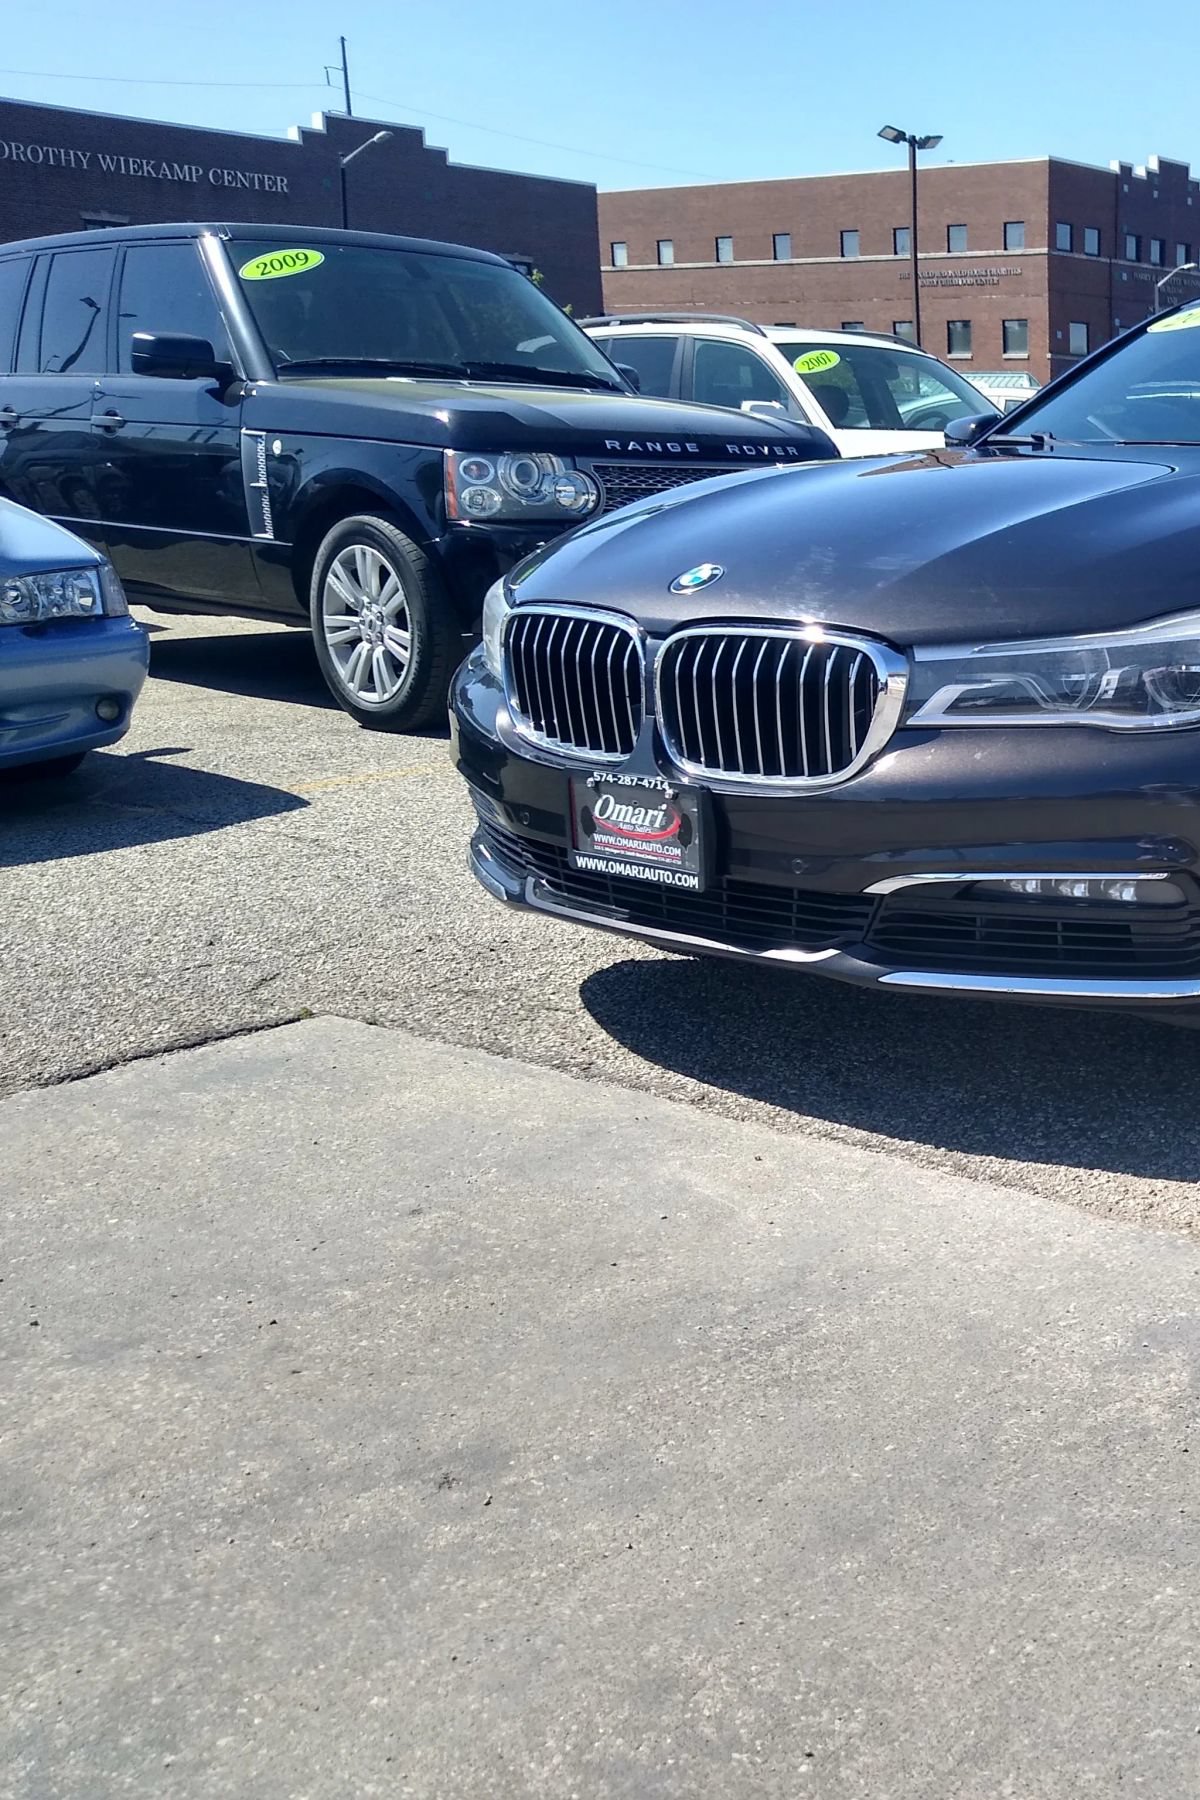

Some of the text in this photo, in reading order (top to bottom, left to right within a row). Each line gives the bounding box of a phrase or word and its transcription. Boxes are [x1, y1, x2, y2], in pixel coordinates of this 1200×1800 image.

[97, 153, 203, 184] WIEKAMP
[208, 167, 289, 194] CENTER
[255, 251, 309, 276] 2009
[801, 352, 832, 371] 2007
[604, 439, 799, 456] RANGE ROVER
[593, 771, 670, 791] 574-287-4714
[593, 833, 682, 857] WWW.OMARIAUTO.COM
[575, 855, 699, 889] WWW.OMARIAUTO.COM
